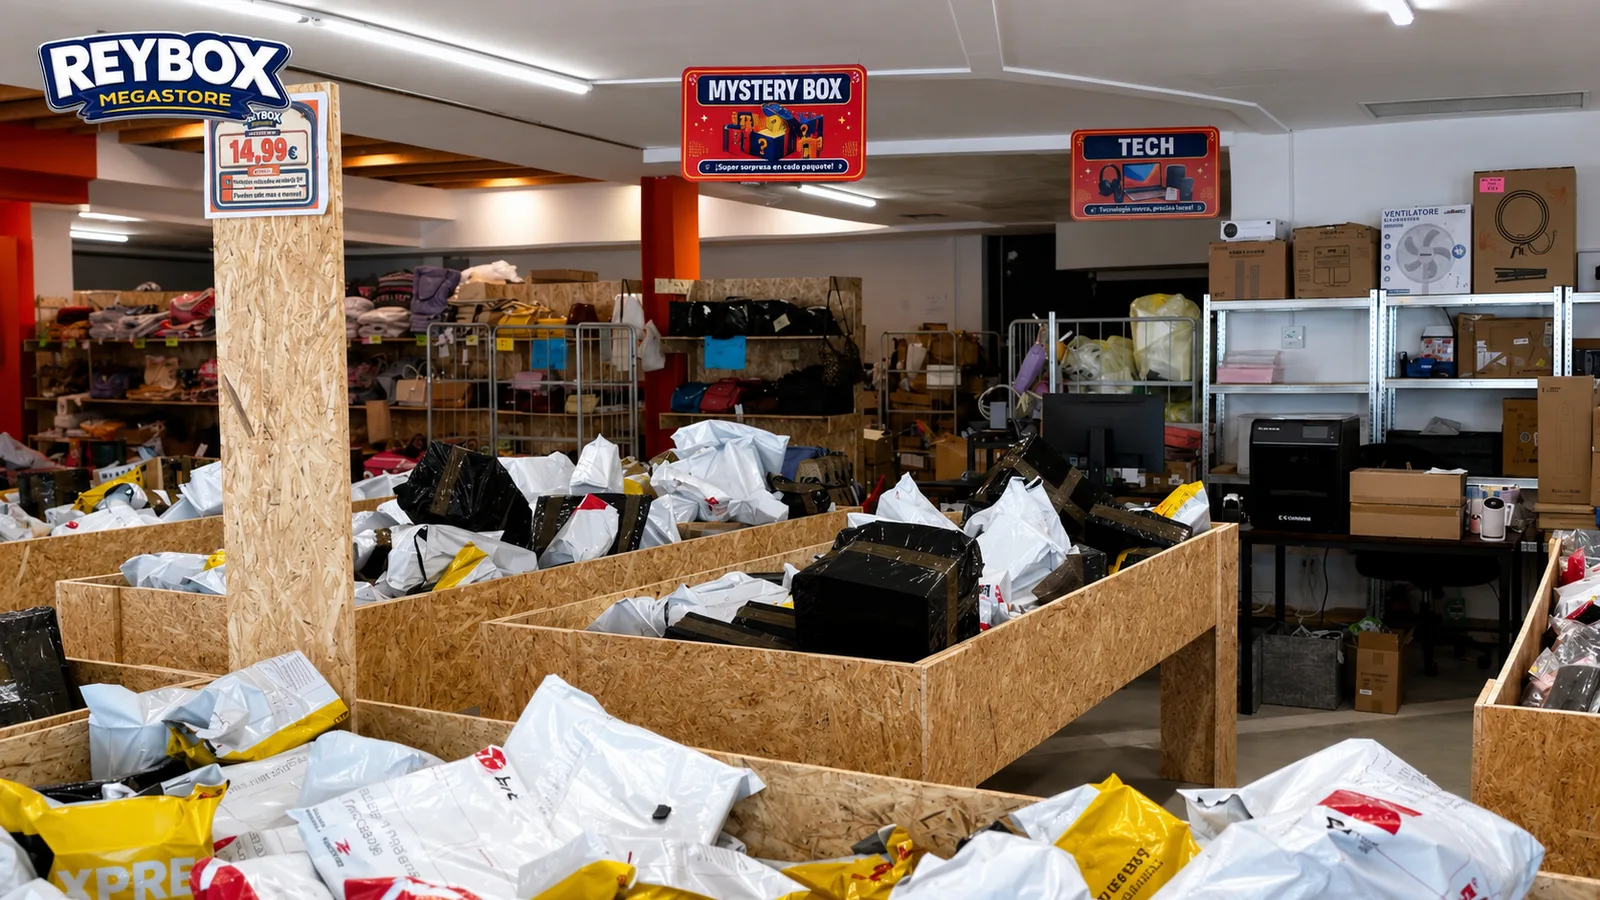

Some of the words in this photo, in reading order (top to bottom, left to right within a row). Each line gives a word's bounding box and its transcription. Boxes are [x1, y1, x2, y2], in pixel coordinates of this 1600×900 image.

[50, 38, 281, 99] REYBOX
[99, 89, 232, 107] MEGASTORE
[709, 79, 798, 101] MYSTERY
[803, 77, 842, 100] BOX
[1118, 137, 1174, 156] TECH
[1384, 208, 1439, 217] VENTILATORE
